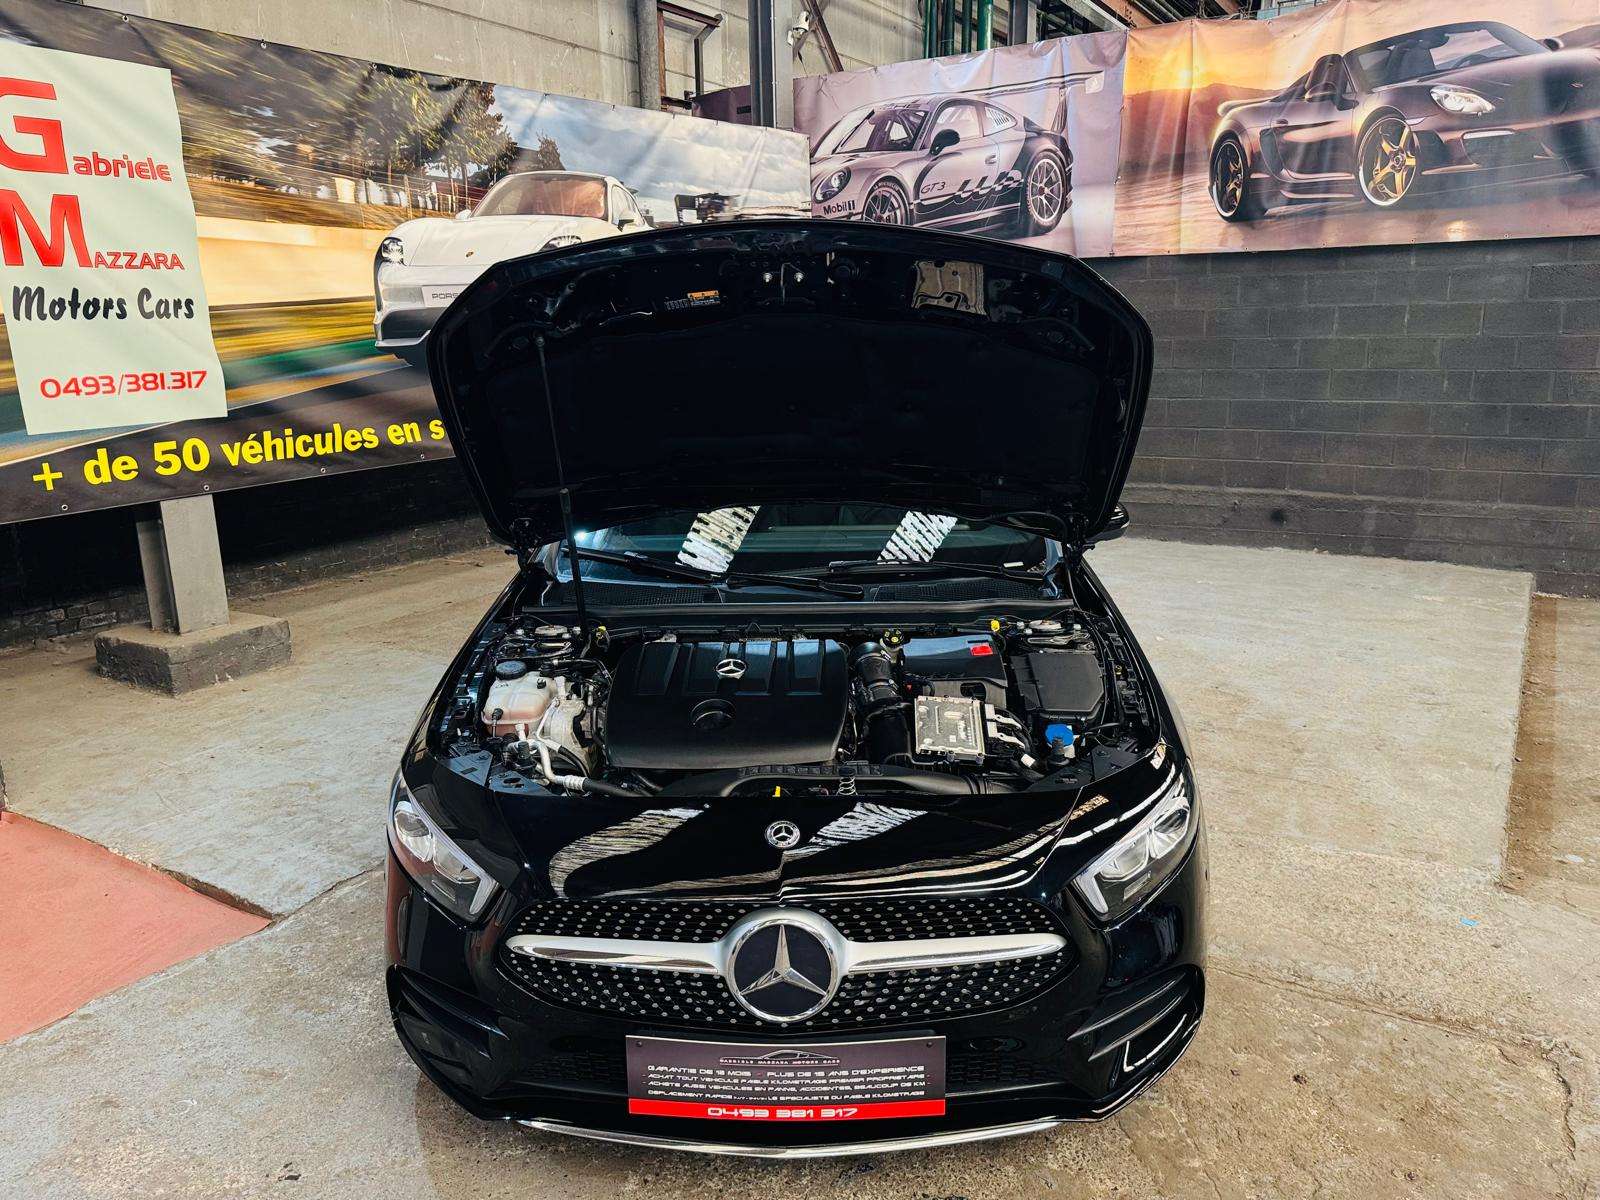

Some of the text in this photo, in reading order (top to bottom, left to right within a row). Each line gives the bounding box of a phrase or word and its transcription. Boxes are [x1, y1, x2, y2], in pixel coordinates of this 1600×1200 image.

[920, 181, 946, 195] GT3
[12, 285, 195, 321] Motors Cars
[39, 370, 207, 399] 0493/381.317
[83, 447, 139, 486] de
[153, 437, 211, 476] 50
[220, 423, 379, 467] véhicules
[386, 421, 422, 445] en
[647, 1065, 697, 1074] GARANTIE
[707, 1107, 858, 1118] 0493 381 317
